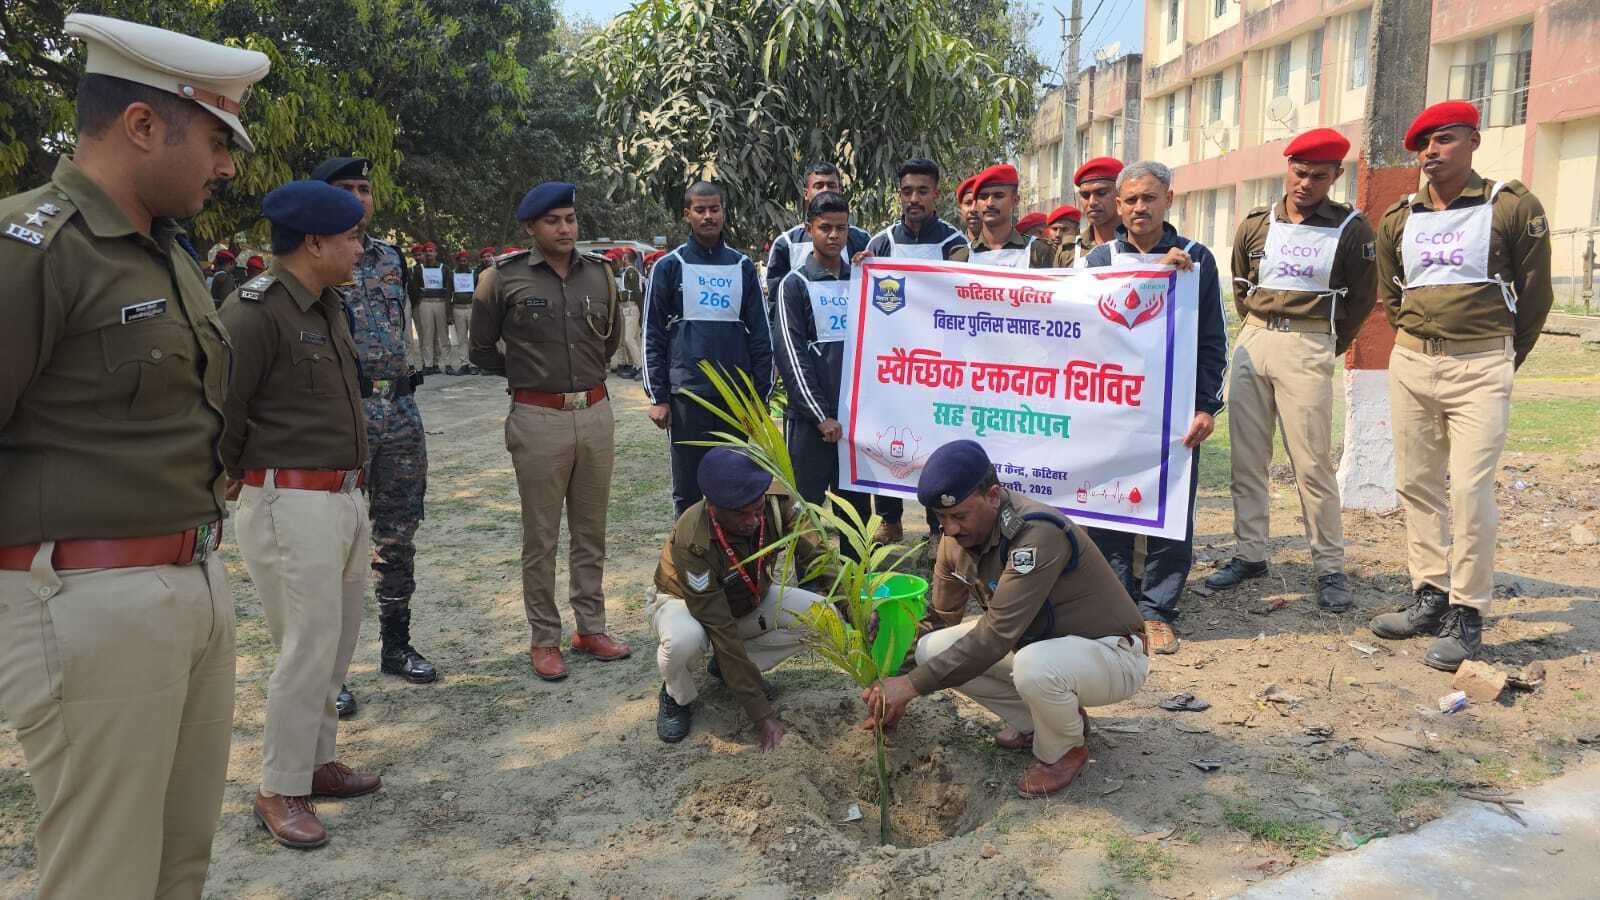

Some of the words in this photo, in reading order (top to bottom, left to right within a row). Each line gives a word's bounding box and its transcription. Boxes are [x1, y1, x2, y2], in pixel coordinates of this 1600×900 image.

[1415, 230, 1465, 245] C-COY
[1280, 244, 1321, 258] C-COY
[1420, 248, 1464, 268] 316
[698, 275, 733, 288] B-COY
[699, 291, 731, 309] 266
[954, 282, 1005, 302] कटिहार
[1008, 286, 1056, 307] पुलिस
[933, 309, 966, 331] बिहार
[968, 311, 1004, 337] पुलिस
[1006, 317, 1081, 339] सप्ताह-2026
[876, 347, 967, 389] स्वैच्छिक
[970, 361, 1060, 399] रक्तदान
[1063, 359, 1146, 407] शिविर
[932, 402, 967, 427] सह
[1031, 467, 1068, 480] कटिहार
[1029, 483, 1053, 496] 2026
